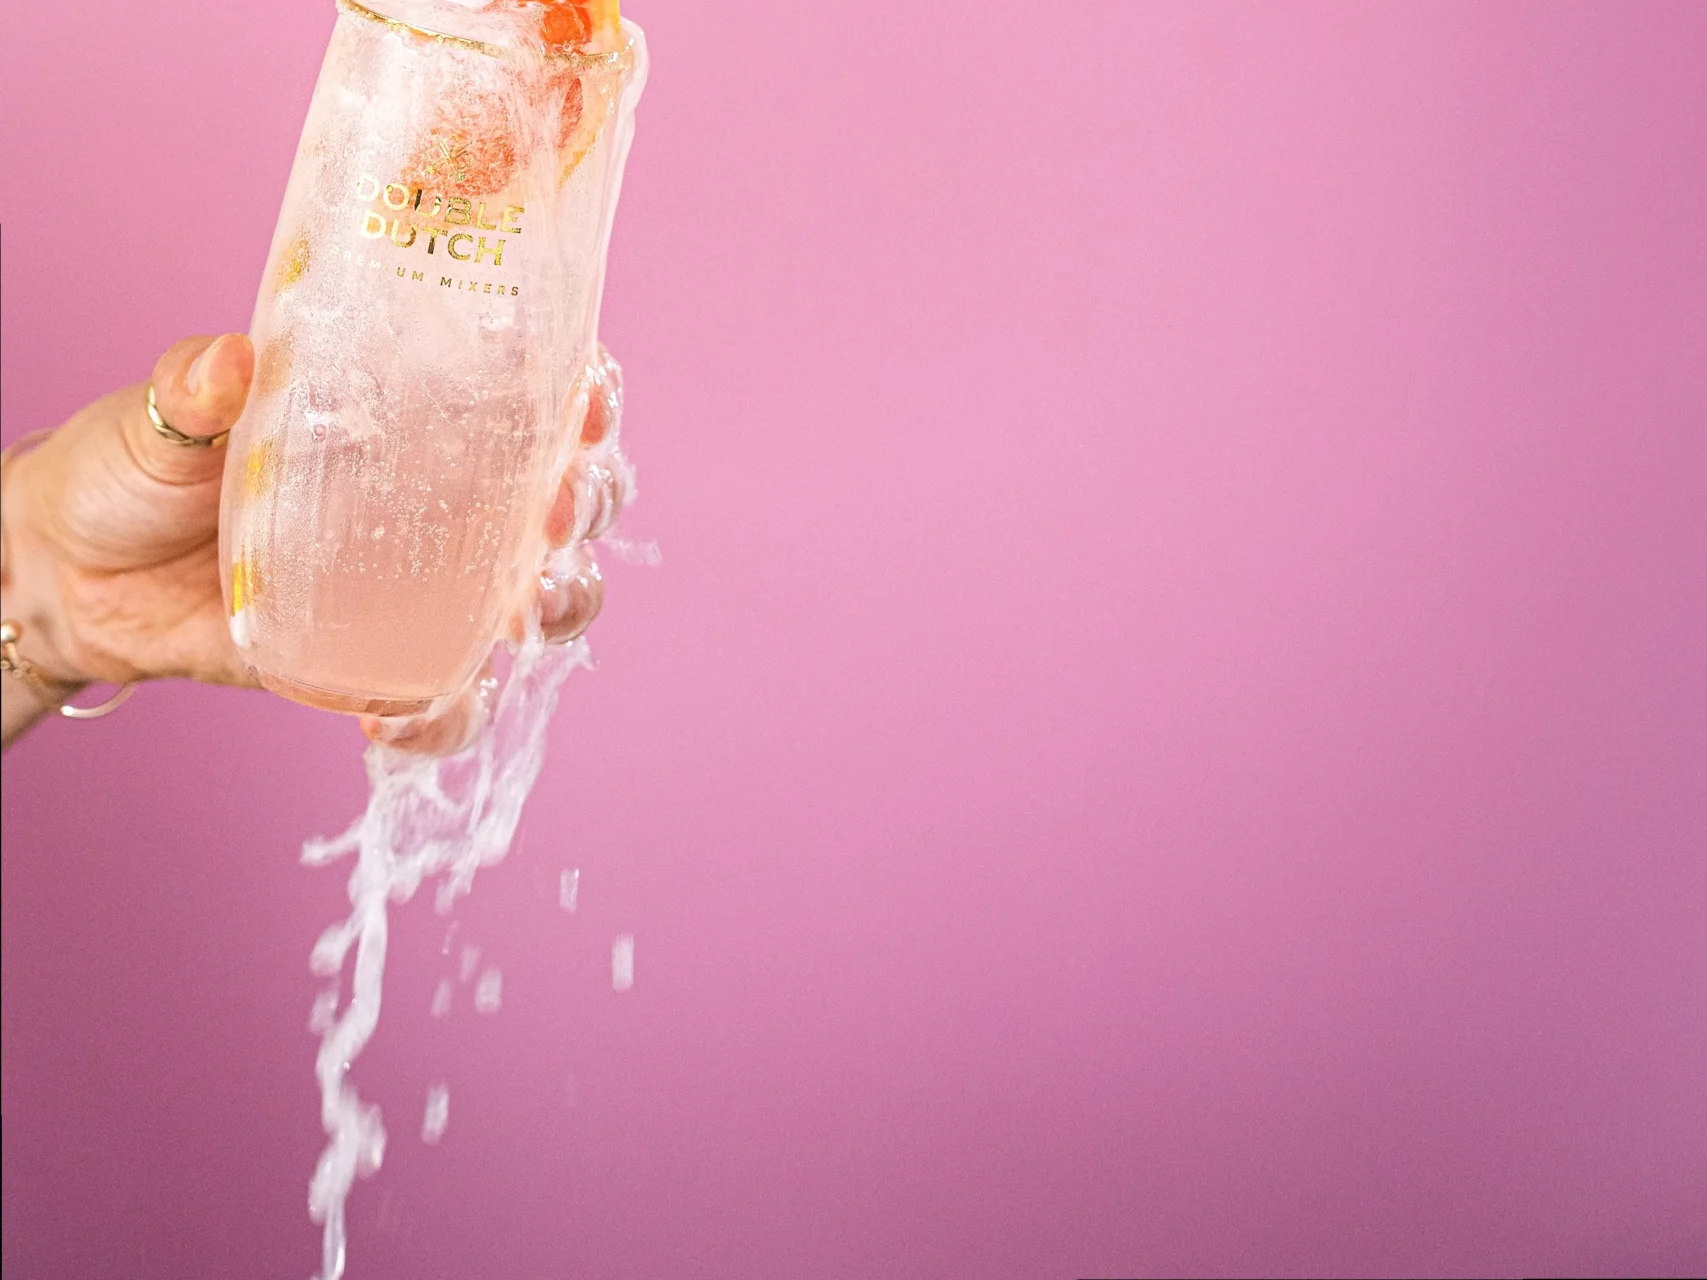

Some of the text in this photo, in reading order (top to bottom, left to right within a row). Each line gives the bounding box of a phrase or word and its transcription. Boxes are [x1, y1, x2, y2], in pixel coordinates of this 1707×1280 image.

[355, 173, 525, 234] DOUBLE
[359, 209, 506, 266] DUTCH
[440, 276, 519, 297] MIXERS
